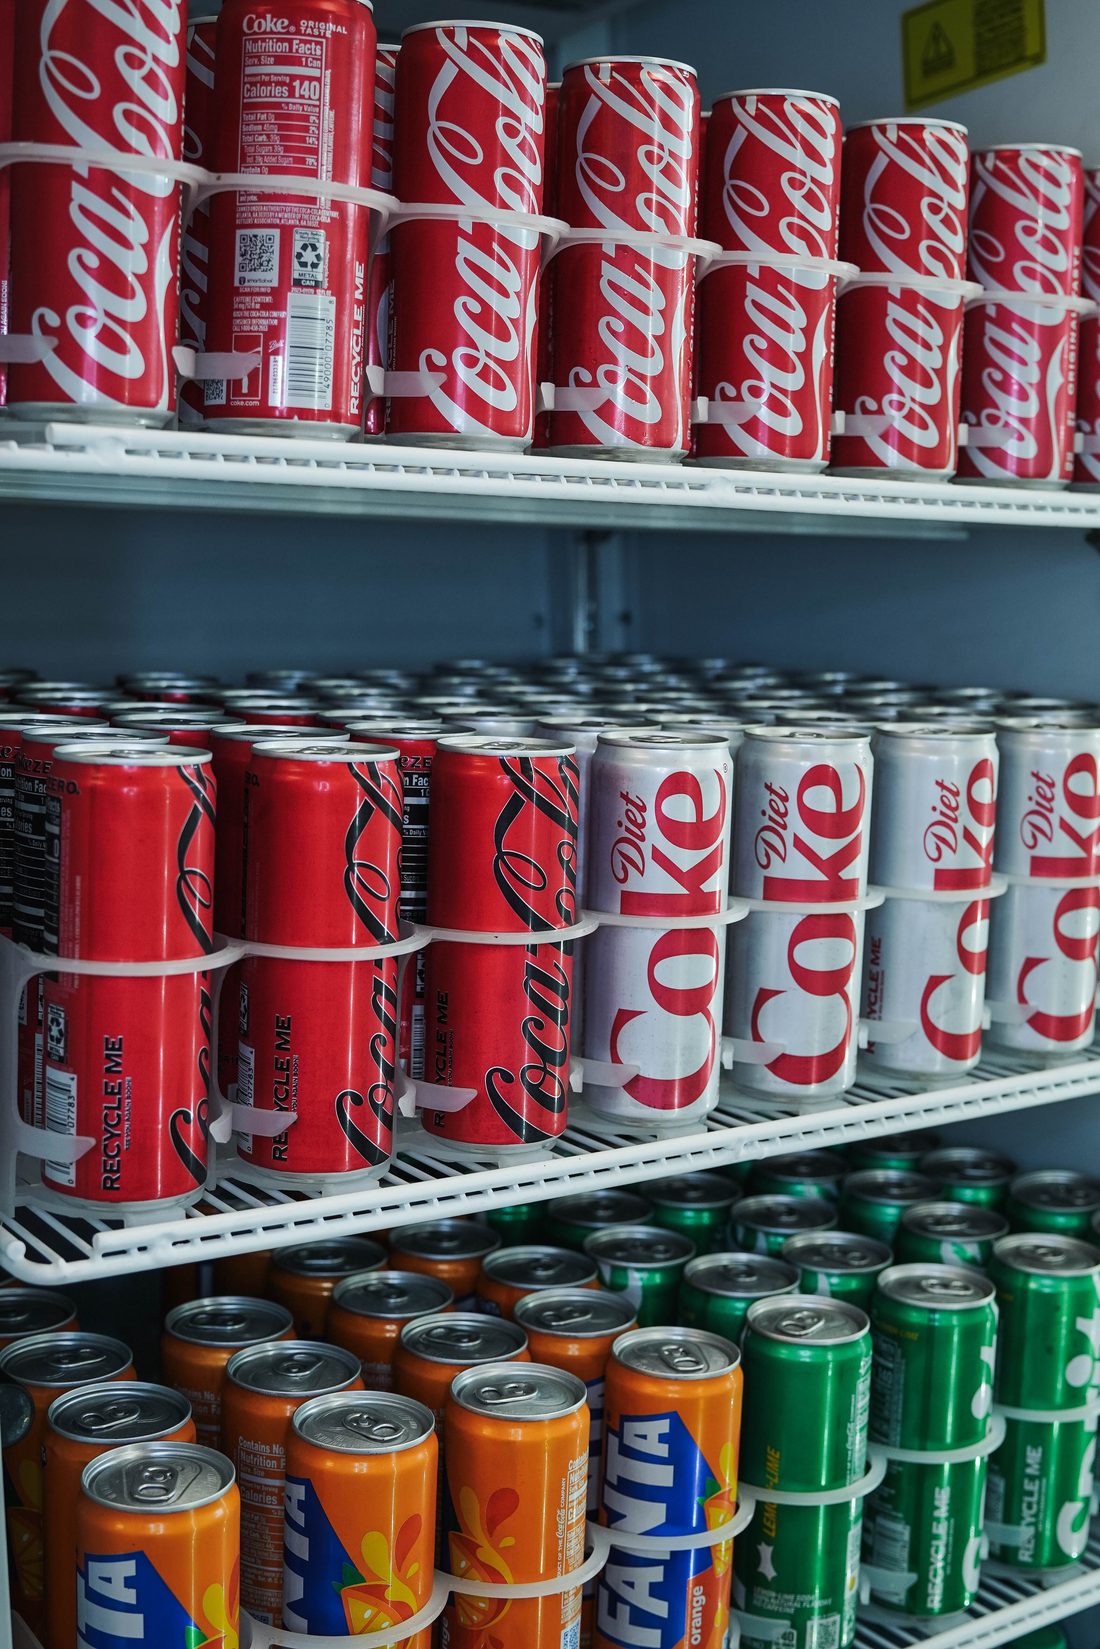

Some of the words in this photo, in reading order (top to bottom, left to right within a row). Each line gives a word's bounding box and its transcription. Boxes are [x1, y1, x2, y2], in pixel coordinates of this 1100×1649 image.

[245, 39, 289, 52] Nutrition
[293, 40, 321, 55] Facts
[300, 19, 348, 34] ORIGINAL
[300, 27, 332, 38] TASTE
[261, 56, 274, 64] Size
[308, 58, 321, 67] Can
[244, 83, 289, 97] Calories
[293, 80, 320, 100] 140
[355, 261, 364, 301] ME
[350, 305, 363, 415] RECYCLE
[754, 782, 790, 870] Diet
[923, 778, 961, 864] Diet
[1020, 770, 1056, 851] Diet
[610, 791, 647, 885] Diet
[610, 766, 727, 1111] Coke
[751, 762, 866, 1085] Coke
[436, 990, 449, 1025] ME
[275, 1014, 292, 1052] ME
[104, 1034, 124, 1075] ME
[433, 1028, 448, 1129] RYCLE
[272, 1056, 290, 1162] REYCLE
[102, 1079, 123, 1191] RECYCLE
[239, 1435, 271, 1454] Contains
[272, 1443, 284, 1455] No
[240, 1450, 277, 1469] Nutrition
[1025, 1444, 1043, 1476] ME
[240, 1486, 278, 1505] Calories
[933, 1486, 950, 1517] ME
[597, 1418, 675, 1649] FANTA
[927, 1521, 948, 1609] RECYCLE
[691, 1586, 706, 1646] orange
